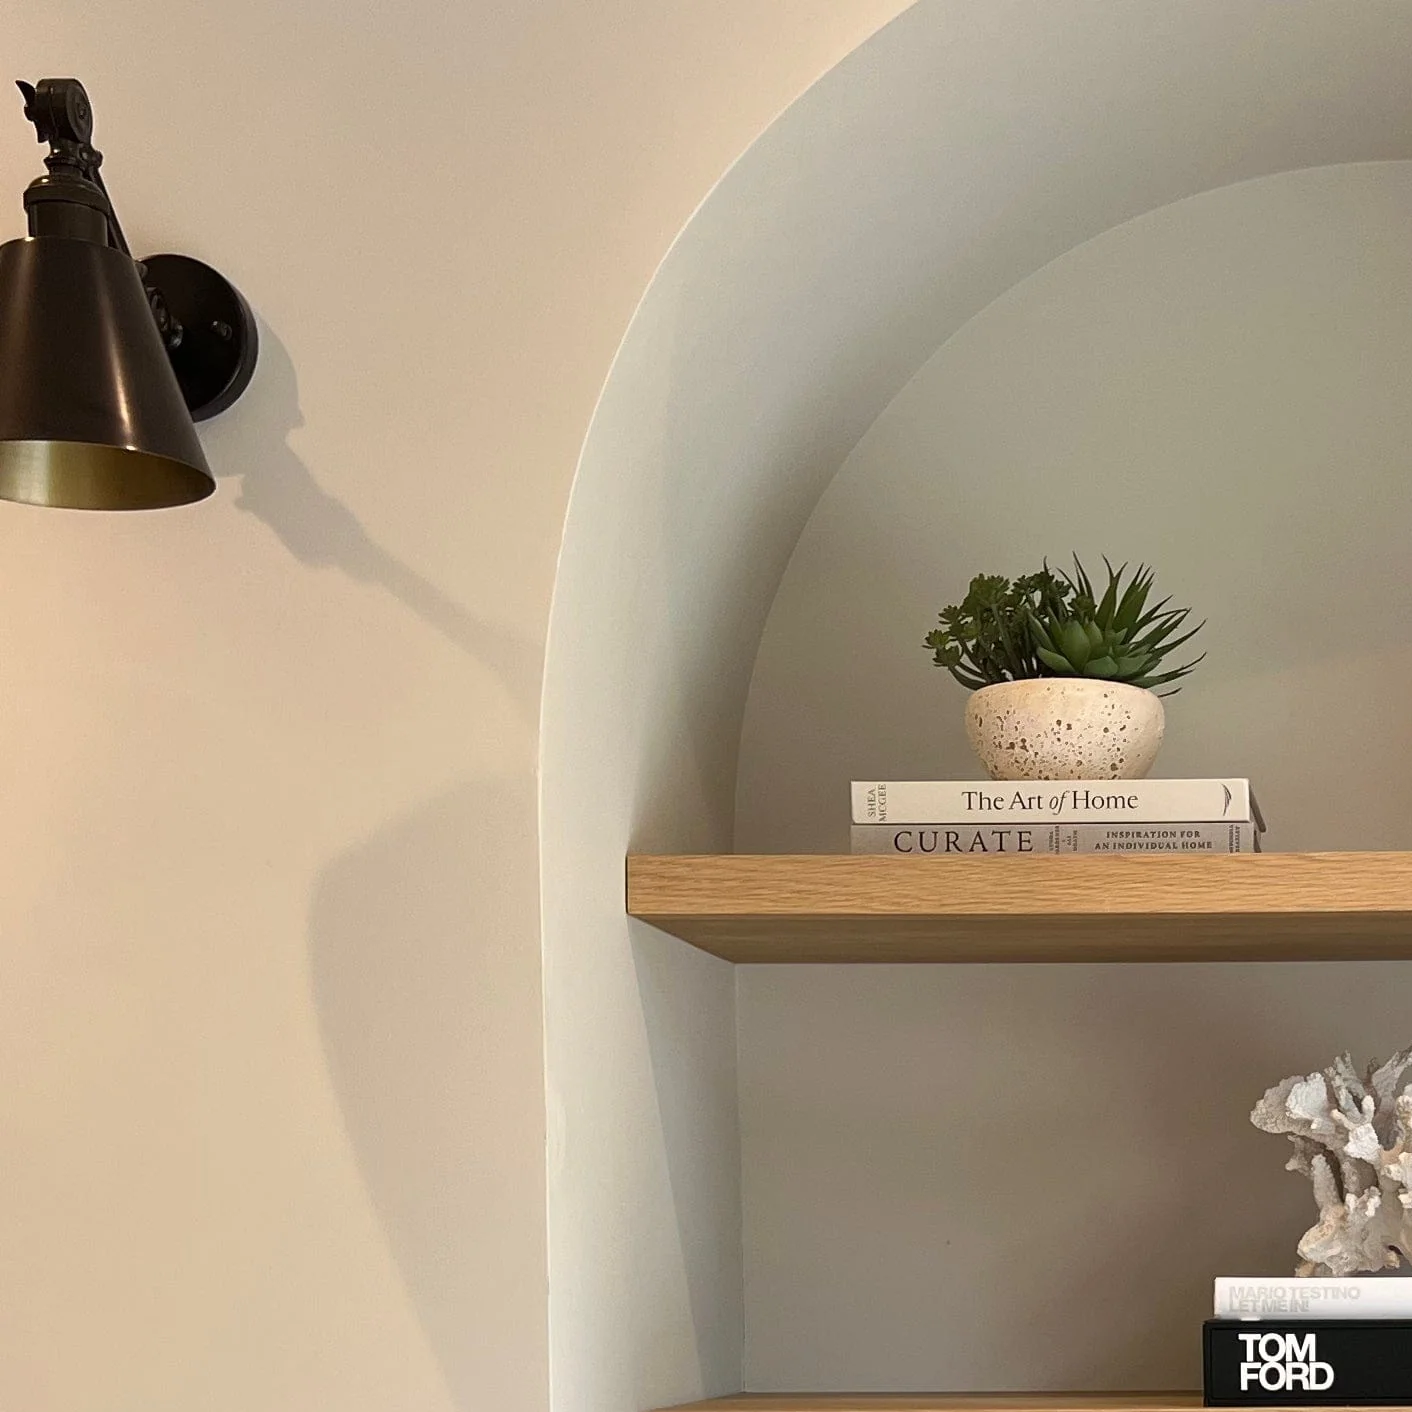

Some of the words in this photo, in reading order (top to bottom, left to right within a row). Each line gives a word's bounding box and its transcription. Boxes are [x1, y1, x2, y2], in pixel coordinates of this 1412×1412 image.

[867, 788, 876, 818] SHEA
[961, 790, 1004, 811] The
[1008, 790, 1043, 810] Art
[1049, 789, 1069, 816] of
[1072, 789, 1138, 810] Home
[893, 830, 1033, 853] CURATE
[1094, 841, 1110, 850] AN
[1112, 841, 1178, 850] INDIVIDUAL
[1181, 841, 1213, 850] HOME
[1106, 830, 1177, 839] INSPIRATION
[1180, 830, 1201, 839] FOR
[1229, 1286, 1287, 1300] MARIO
[1290, 1286, 1361, 1300] TESTINO
[1261, 1300, 1289, 1313] ME
[1238, 1332, 1316, 1362] TOM
[1240, 1361, 1335, 1391] FORD
